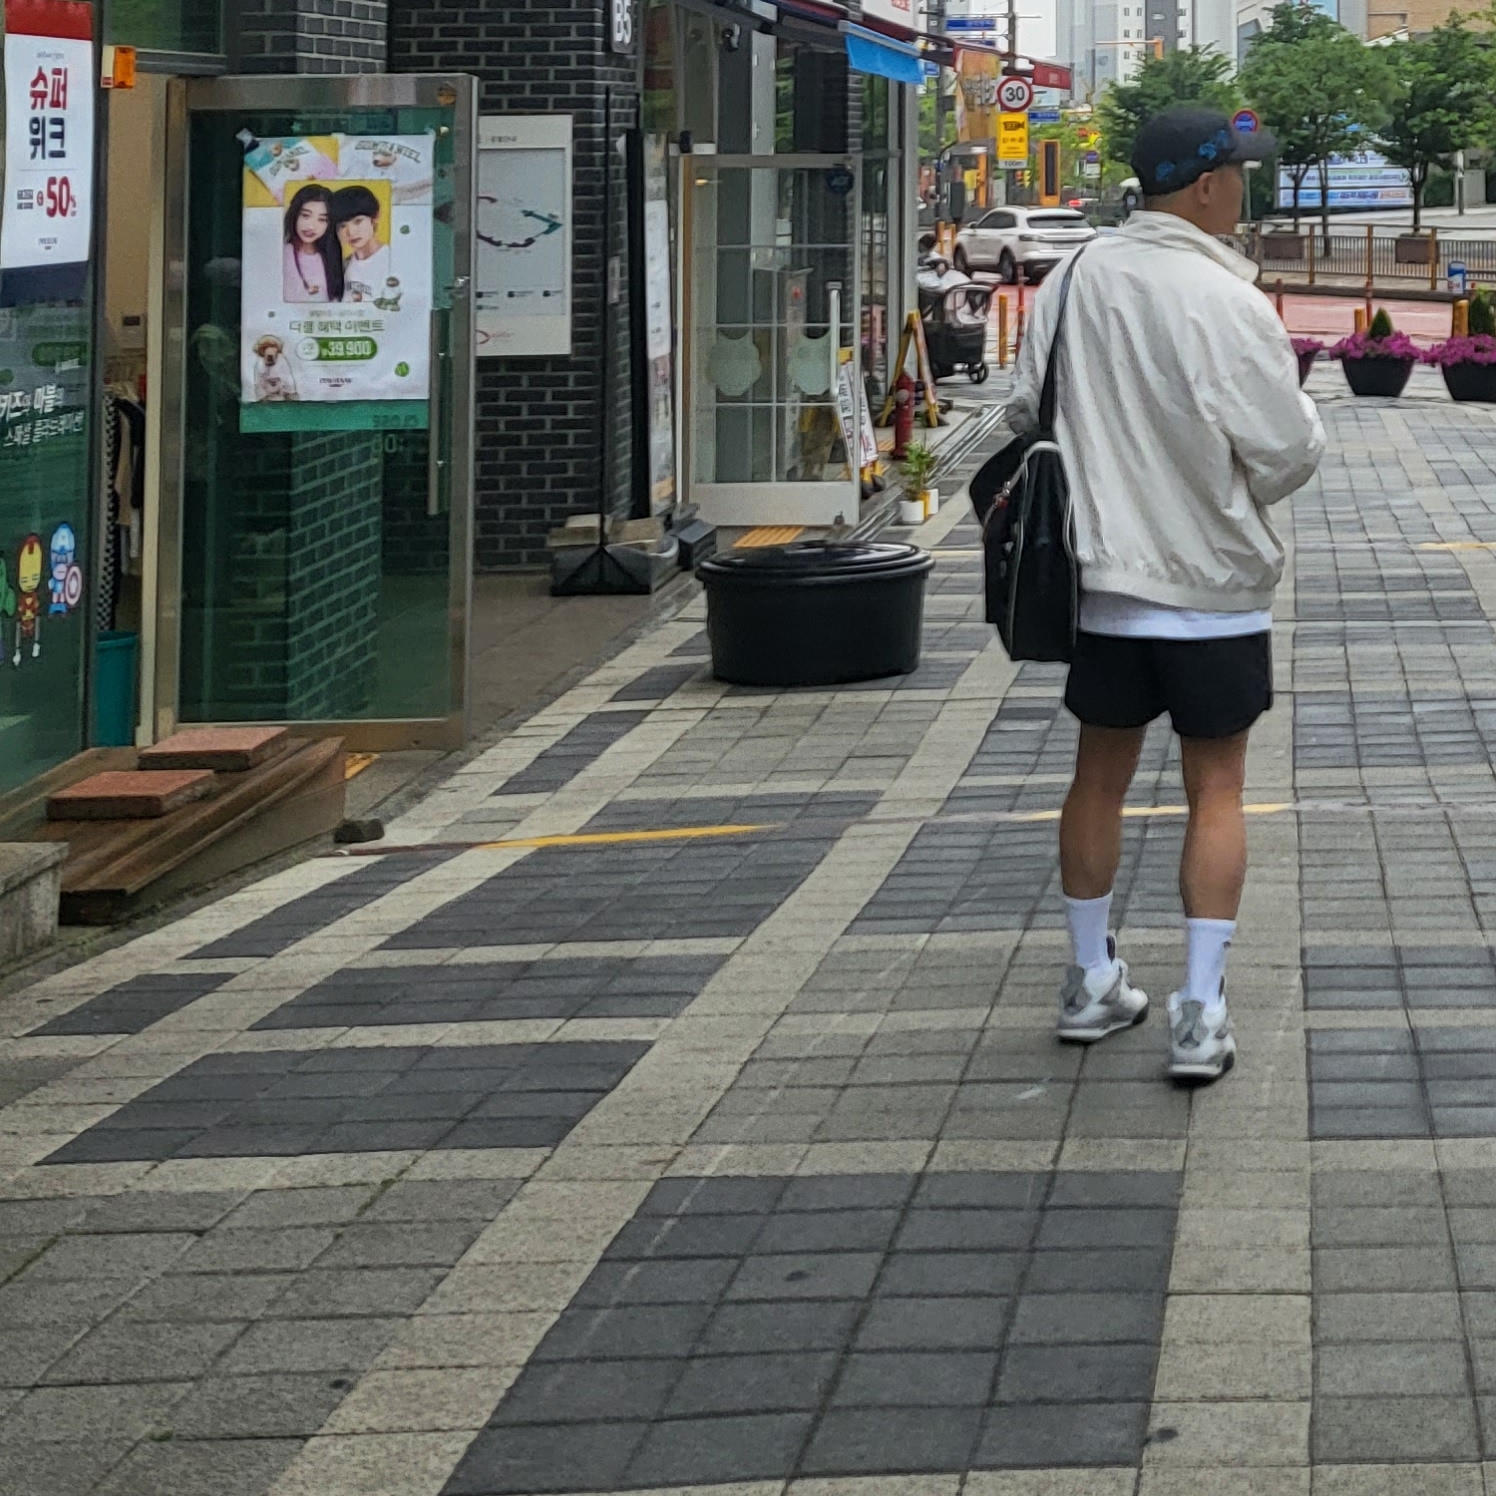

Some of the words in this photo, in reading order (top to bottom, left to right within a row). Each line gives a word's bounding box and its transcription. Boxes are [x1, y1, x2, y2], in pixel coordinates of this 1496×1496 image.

[29, 66, 68, 111] 슈퍼
[1005, 85, 1025, 102] 30
[29, 115, 67, 160] 위크
